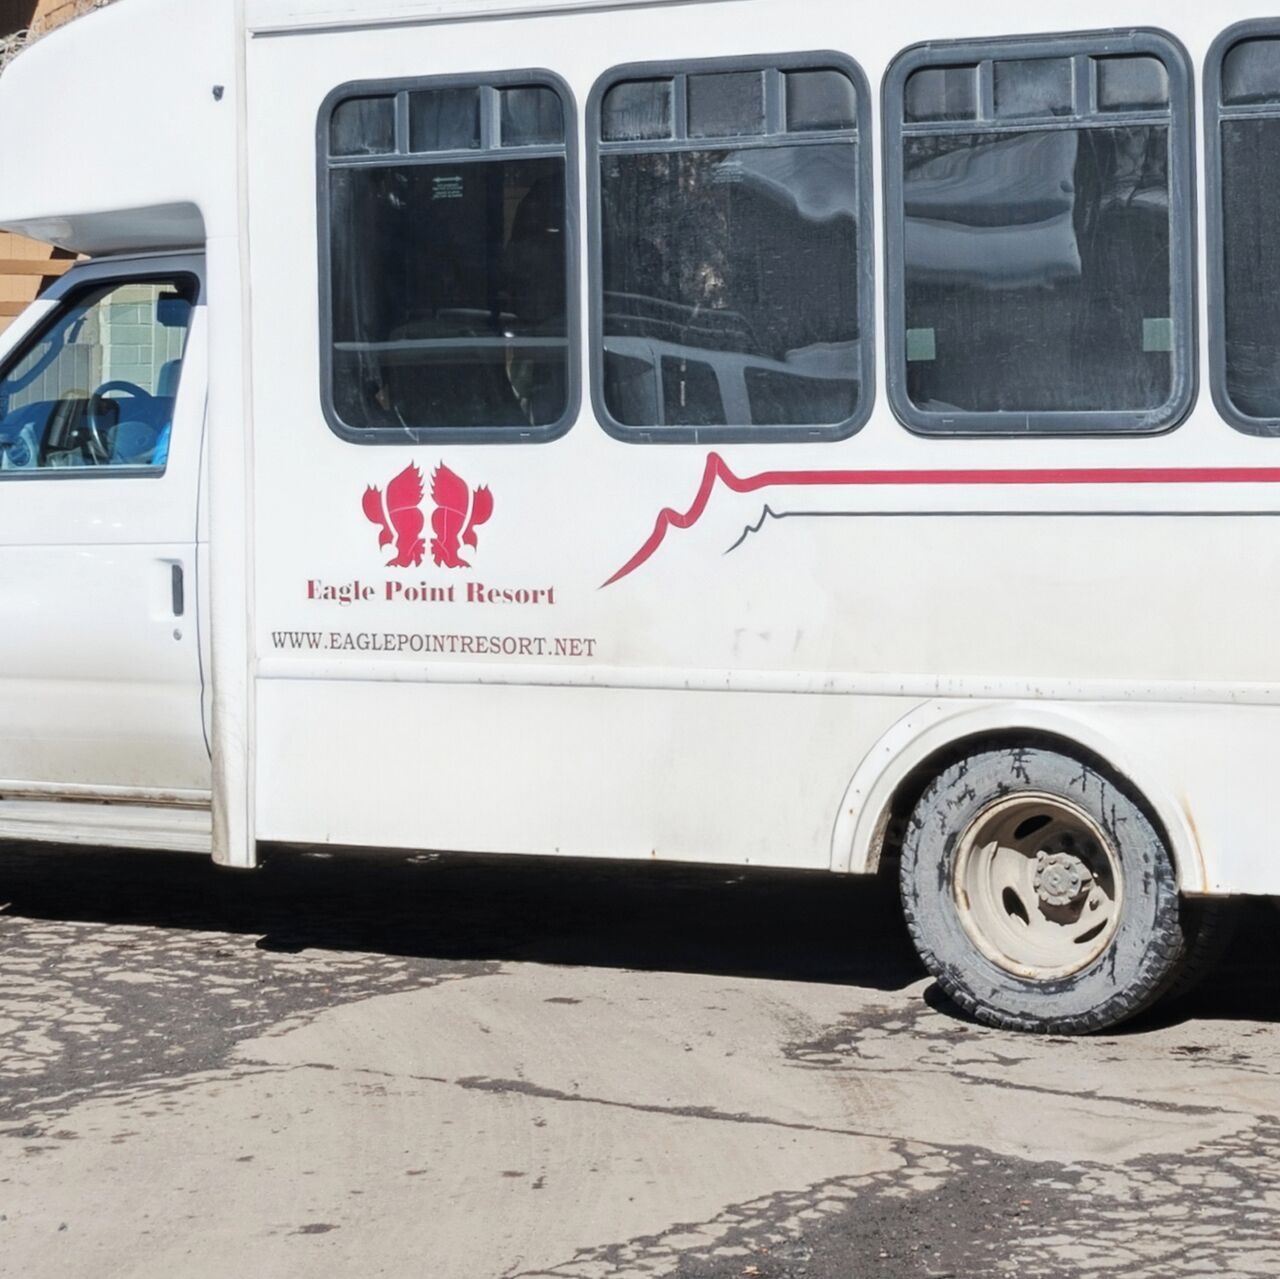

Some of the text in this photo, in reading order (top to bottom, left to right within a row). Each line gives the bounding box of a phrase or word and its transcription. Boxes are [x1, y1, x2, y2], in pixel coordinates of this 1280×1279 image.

[306, 578, 557, 606] Eagle Point Resort
[270, 631, 598, 657] WWW.EAGLEPOINTRESORT.NET
